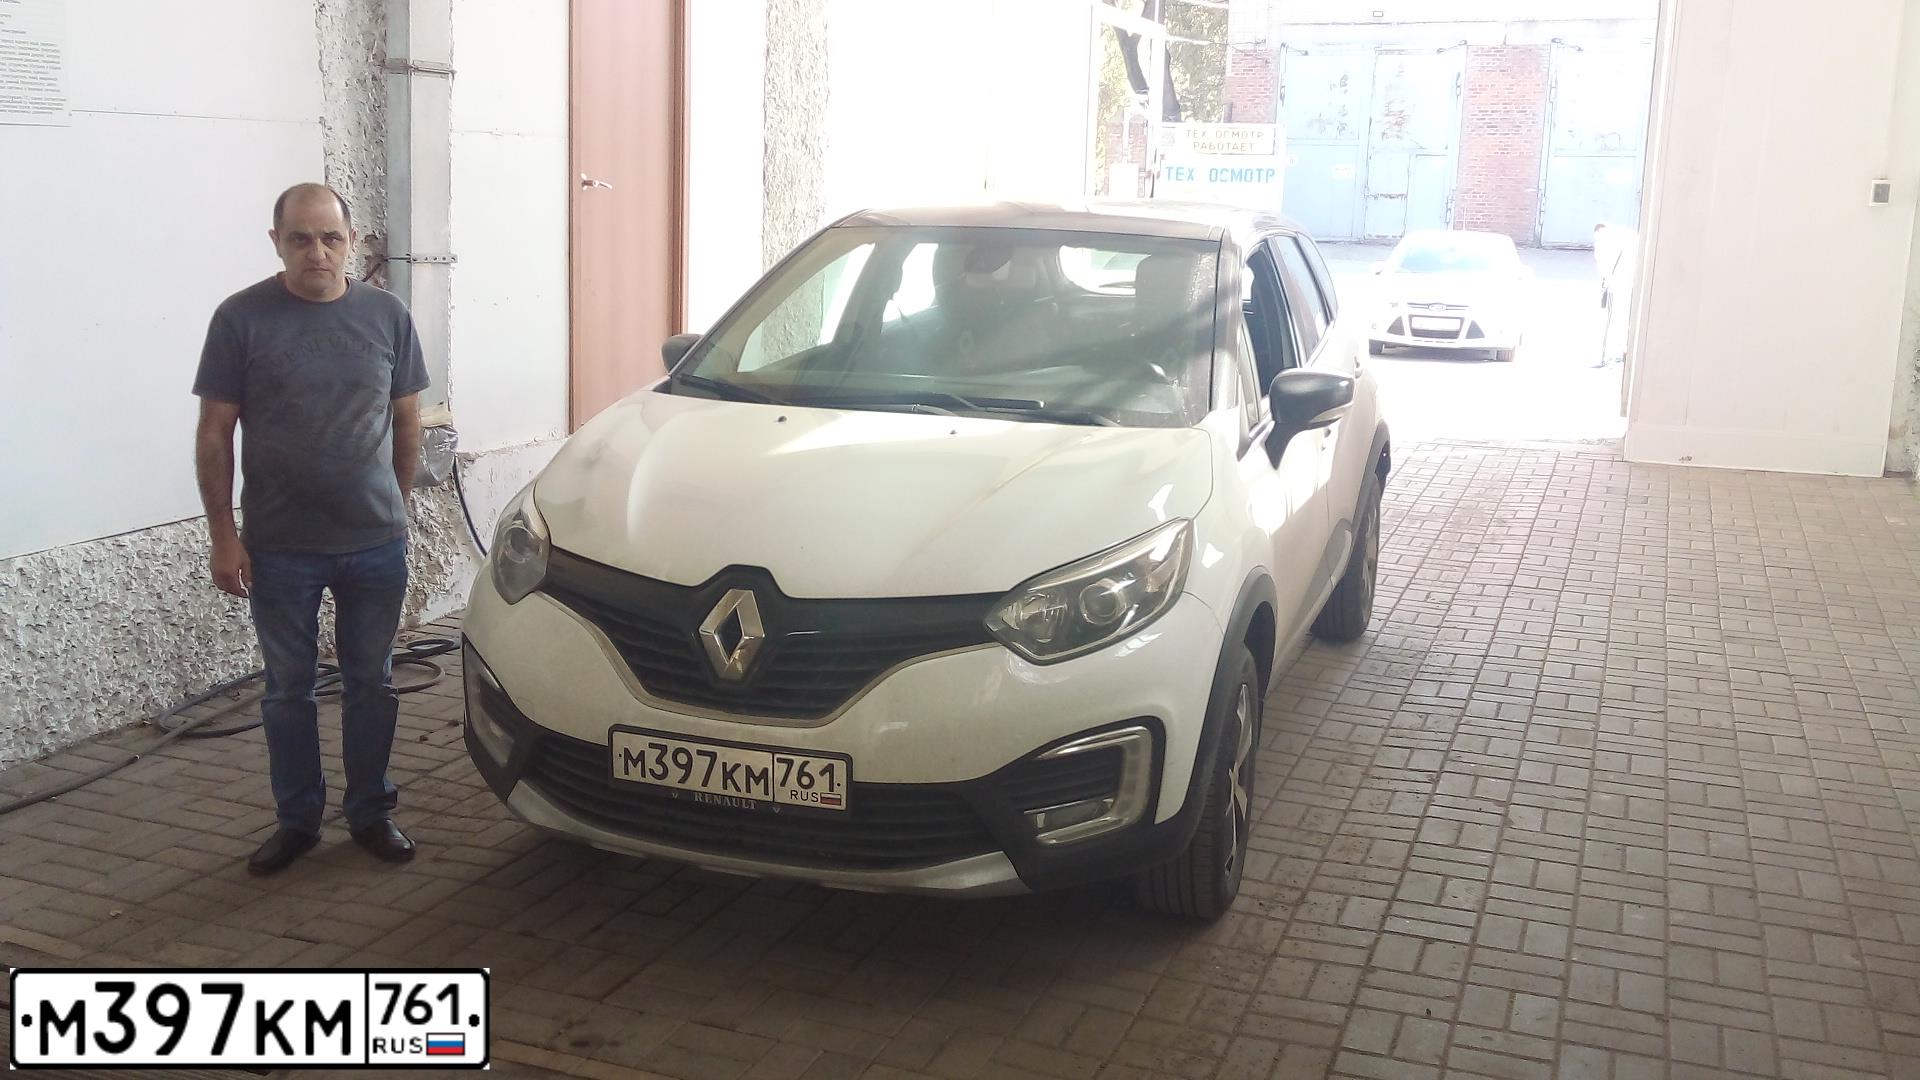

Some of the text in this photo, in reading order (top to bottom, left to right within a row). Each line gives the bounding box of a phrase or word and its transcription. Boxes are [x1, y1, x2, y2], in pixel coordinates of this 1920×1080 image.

[1185, 129, 1265, 139] ТЕХ ОСМОТР
[1193, 141, 1255, 152] РАБОТАЕТ
[1166, 166, 1276, 183] ТЕХ ОСМОТР
[776, 757, 835, 793] 761
[694, 792, 757, 810] RENAULT
[790, 789, 819, 803] RUS
